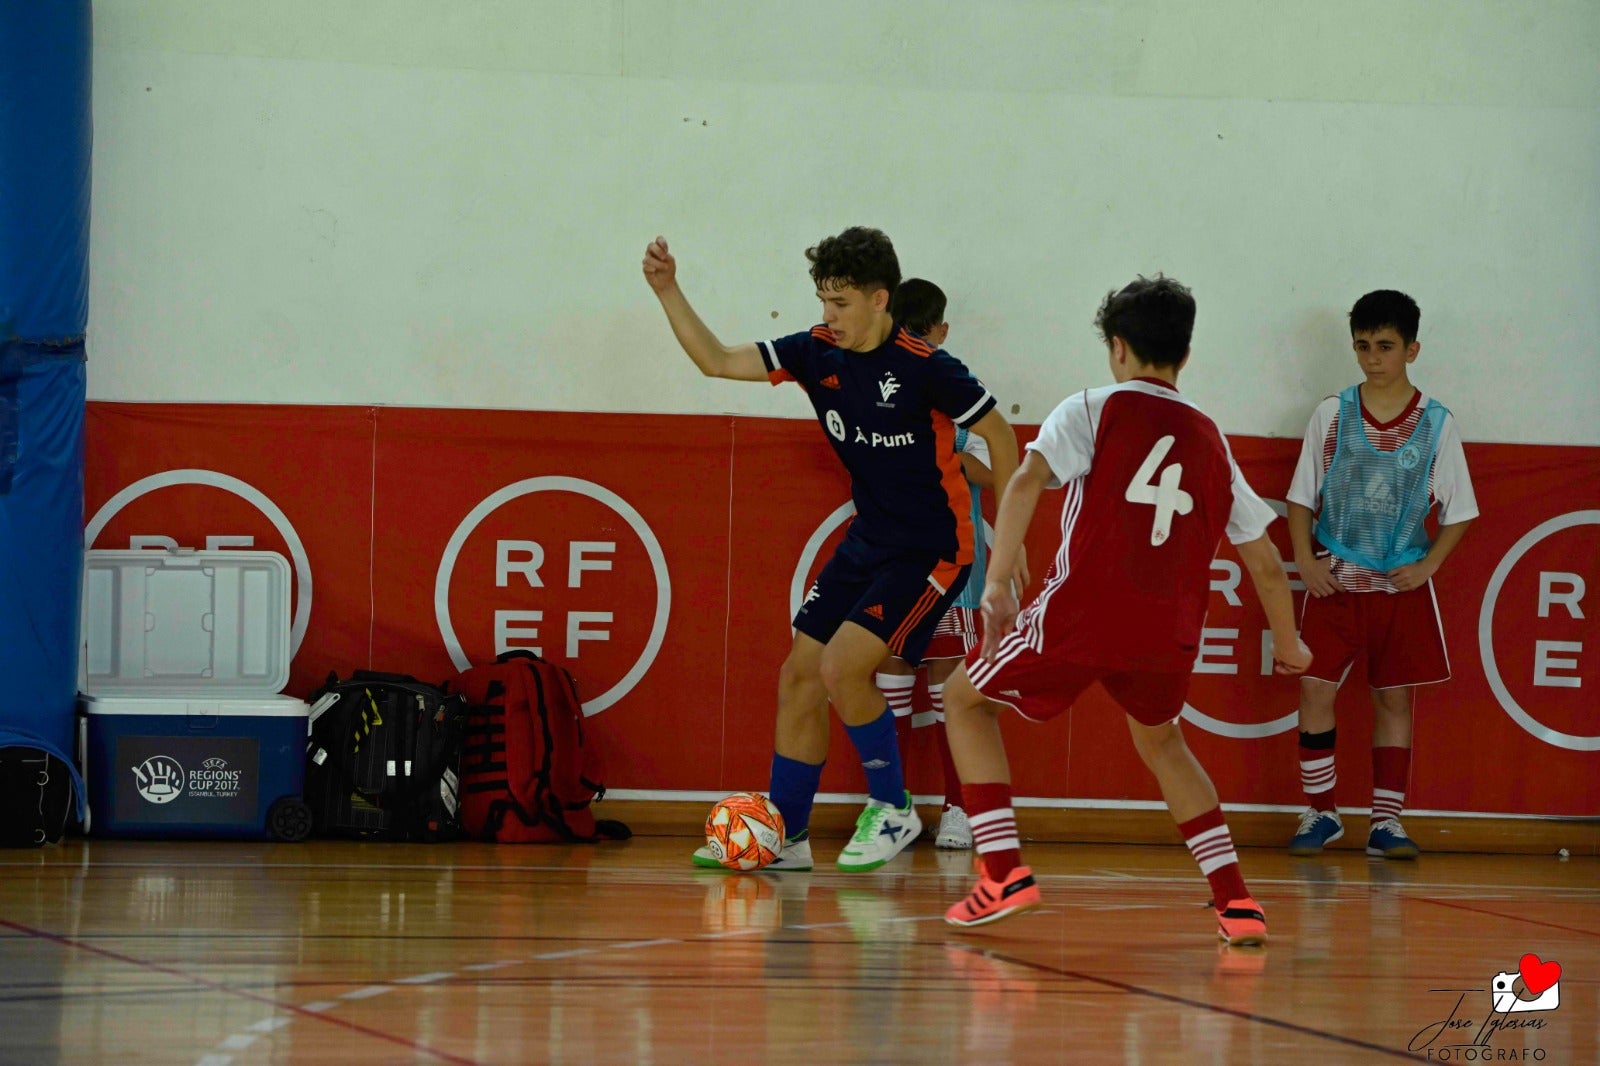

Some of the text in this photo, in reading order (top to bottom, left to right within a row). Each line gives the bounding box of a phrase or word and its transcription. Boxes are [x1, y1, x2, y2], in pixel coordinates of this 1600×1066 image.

[854, 425, 915, 448] À Punt
[1125, 434, 1194, 546] 4
[203, 758, 227, 770] UEFA
[189, 780, 238, 791] CUP 2017
